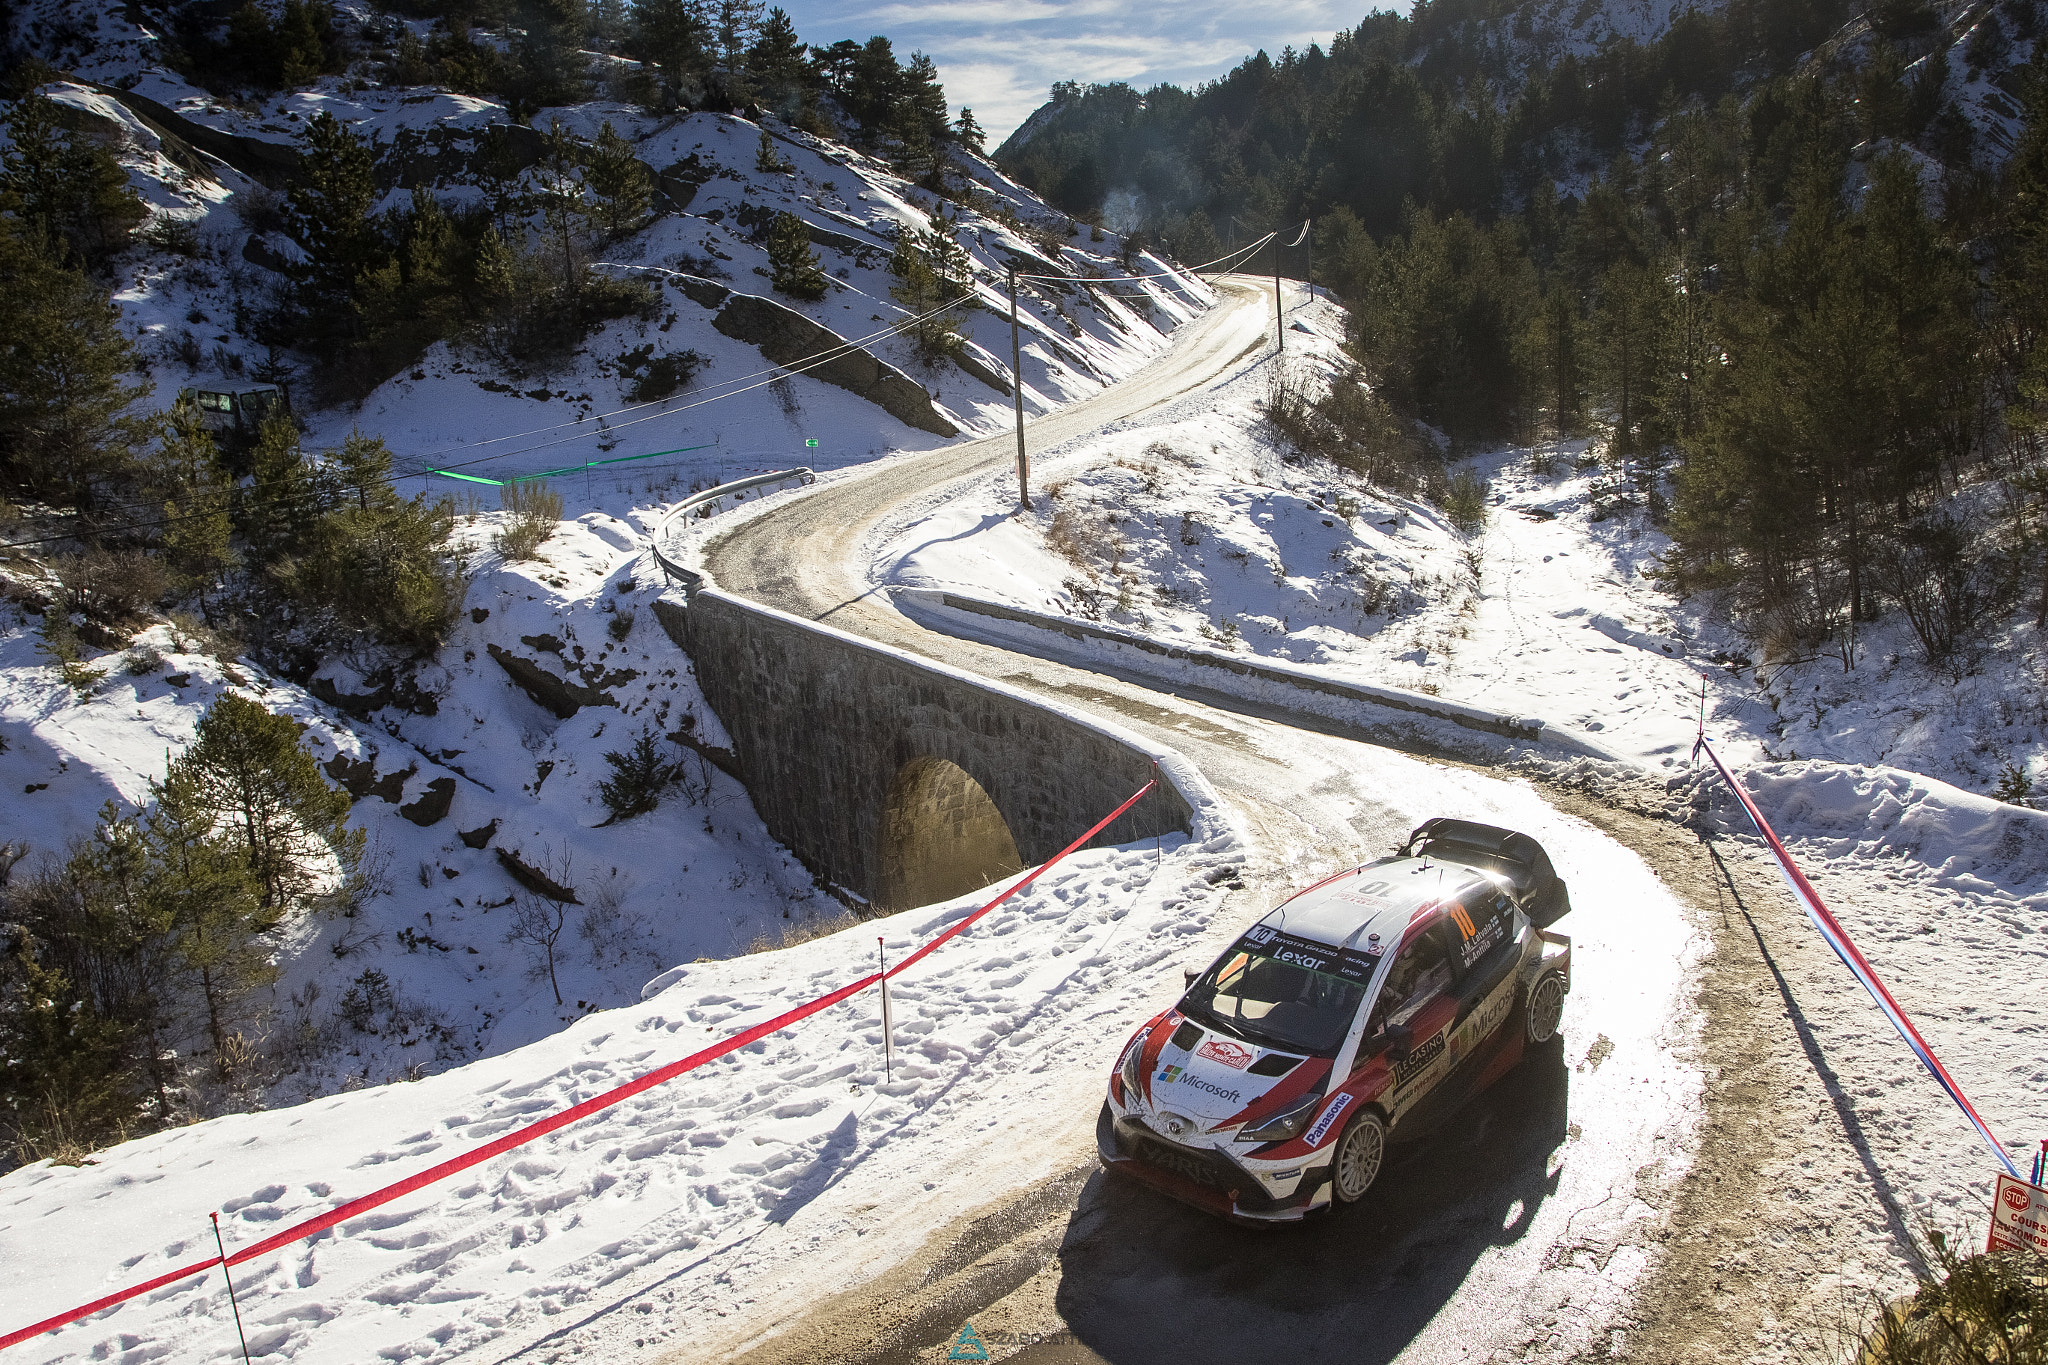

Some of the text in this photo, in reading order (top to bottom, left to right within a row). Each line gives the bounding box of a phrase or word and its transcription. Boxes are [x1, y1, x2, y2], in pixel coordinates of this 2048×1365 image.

[1450, 902, 1476, 941] 10
[1244, 941, 1263, 950] Lexar
[1255, 927, 1269, 942] 10
[1272, 935, 1304, 949] TOYOTA
[1304, 944, 1338, 957] GAZOO
[1471, 922, 1494, 946] Latvala
[1273, 945, 1326, 971] Lexar
[1341, 966, 1363, 977] Lexar
[1399, 1033, 1444, 1074] LE CASINO
[1178, 1072, 1241, 1104] Microsoft
[1306, 1094, 1350, 1145] Panasonic
[2005, 1190, 2028, 1206] STOP
